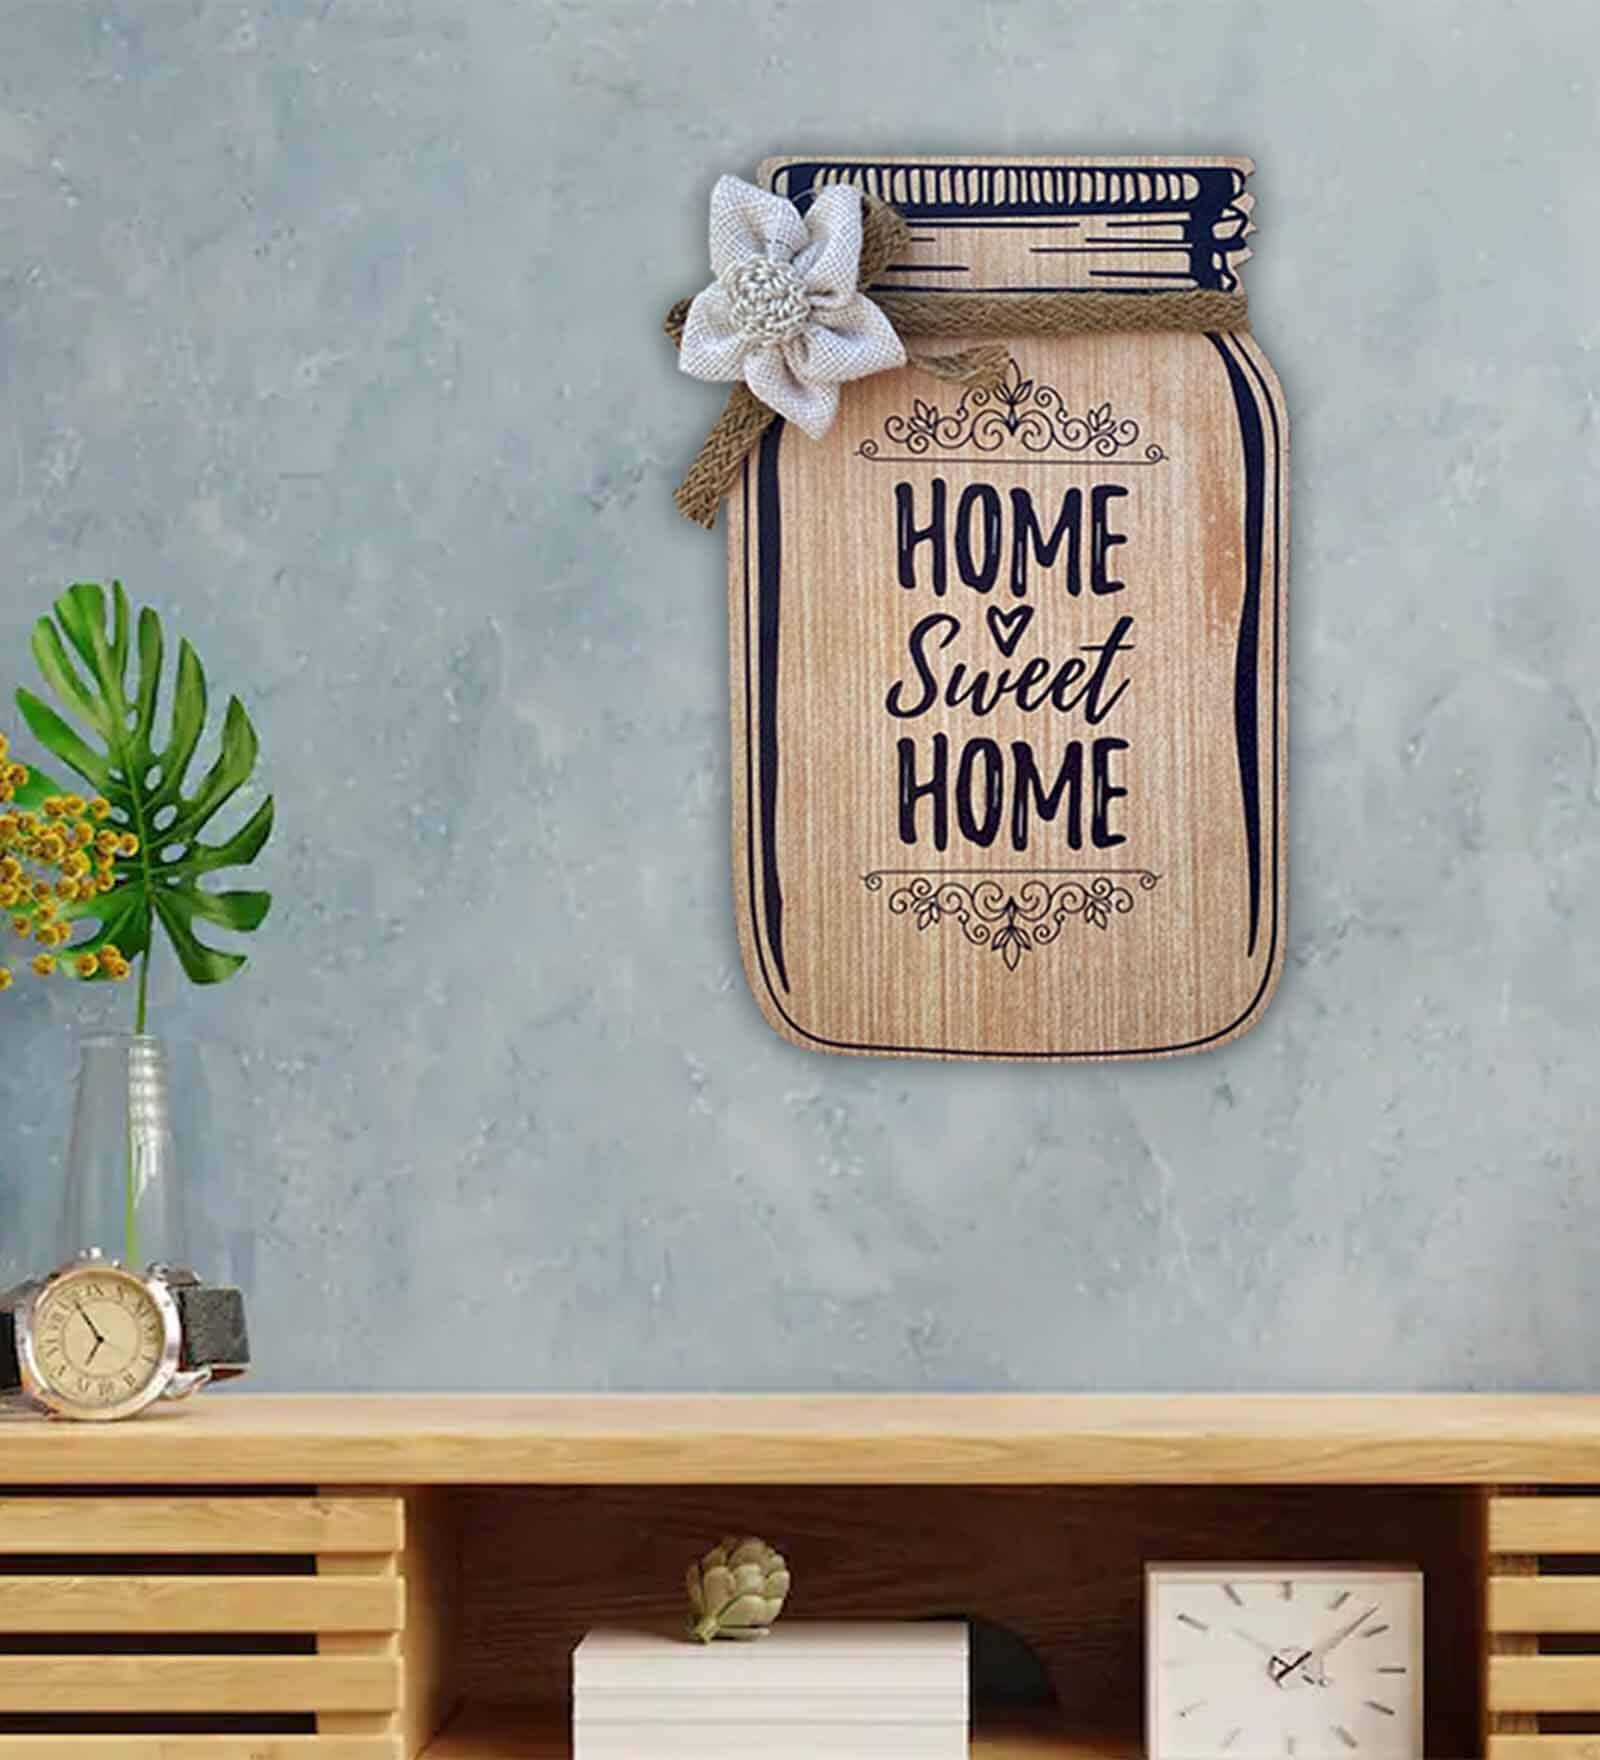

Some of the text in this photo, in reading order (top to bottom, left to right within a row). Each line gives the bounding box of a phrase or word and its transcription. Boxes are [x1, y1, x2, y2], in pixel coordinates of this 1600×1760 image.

[894, 477, 1129, 598] HOME
[885, 612, 1135, 726] Sweet
[896, 732, 1130, 852] HOME
